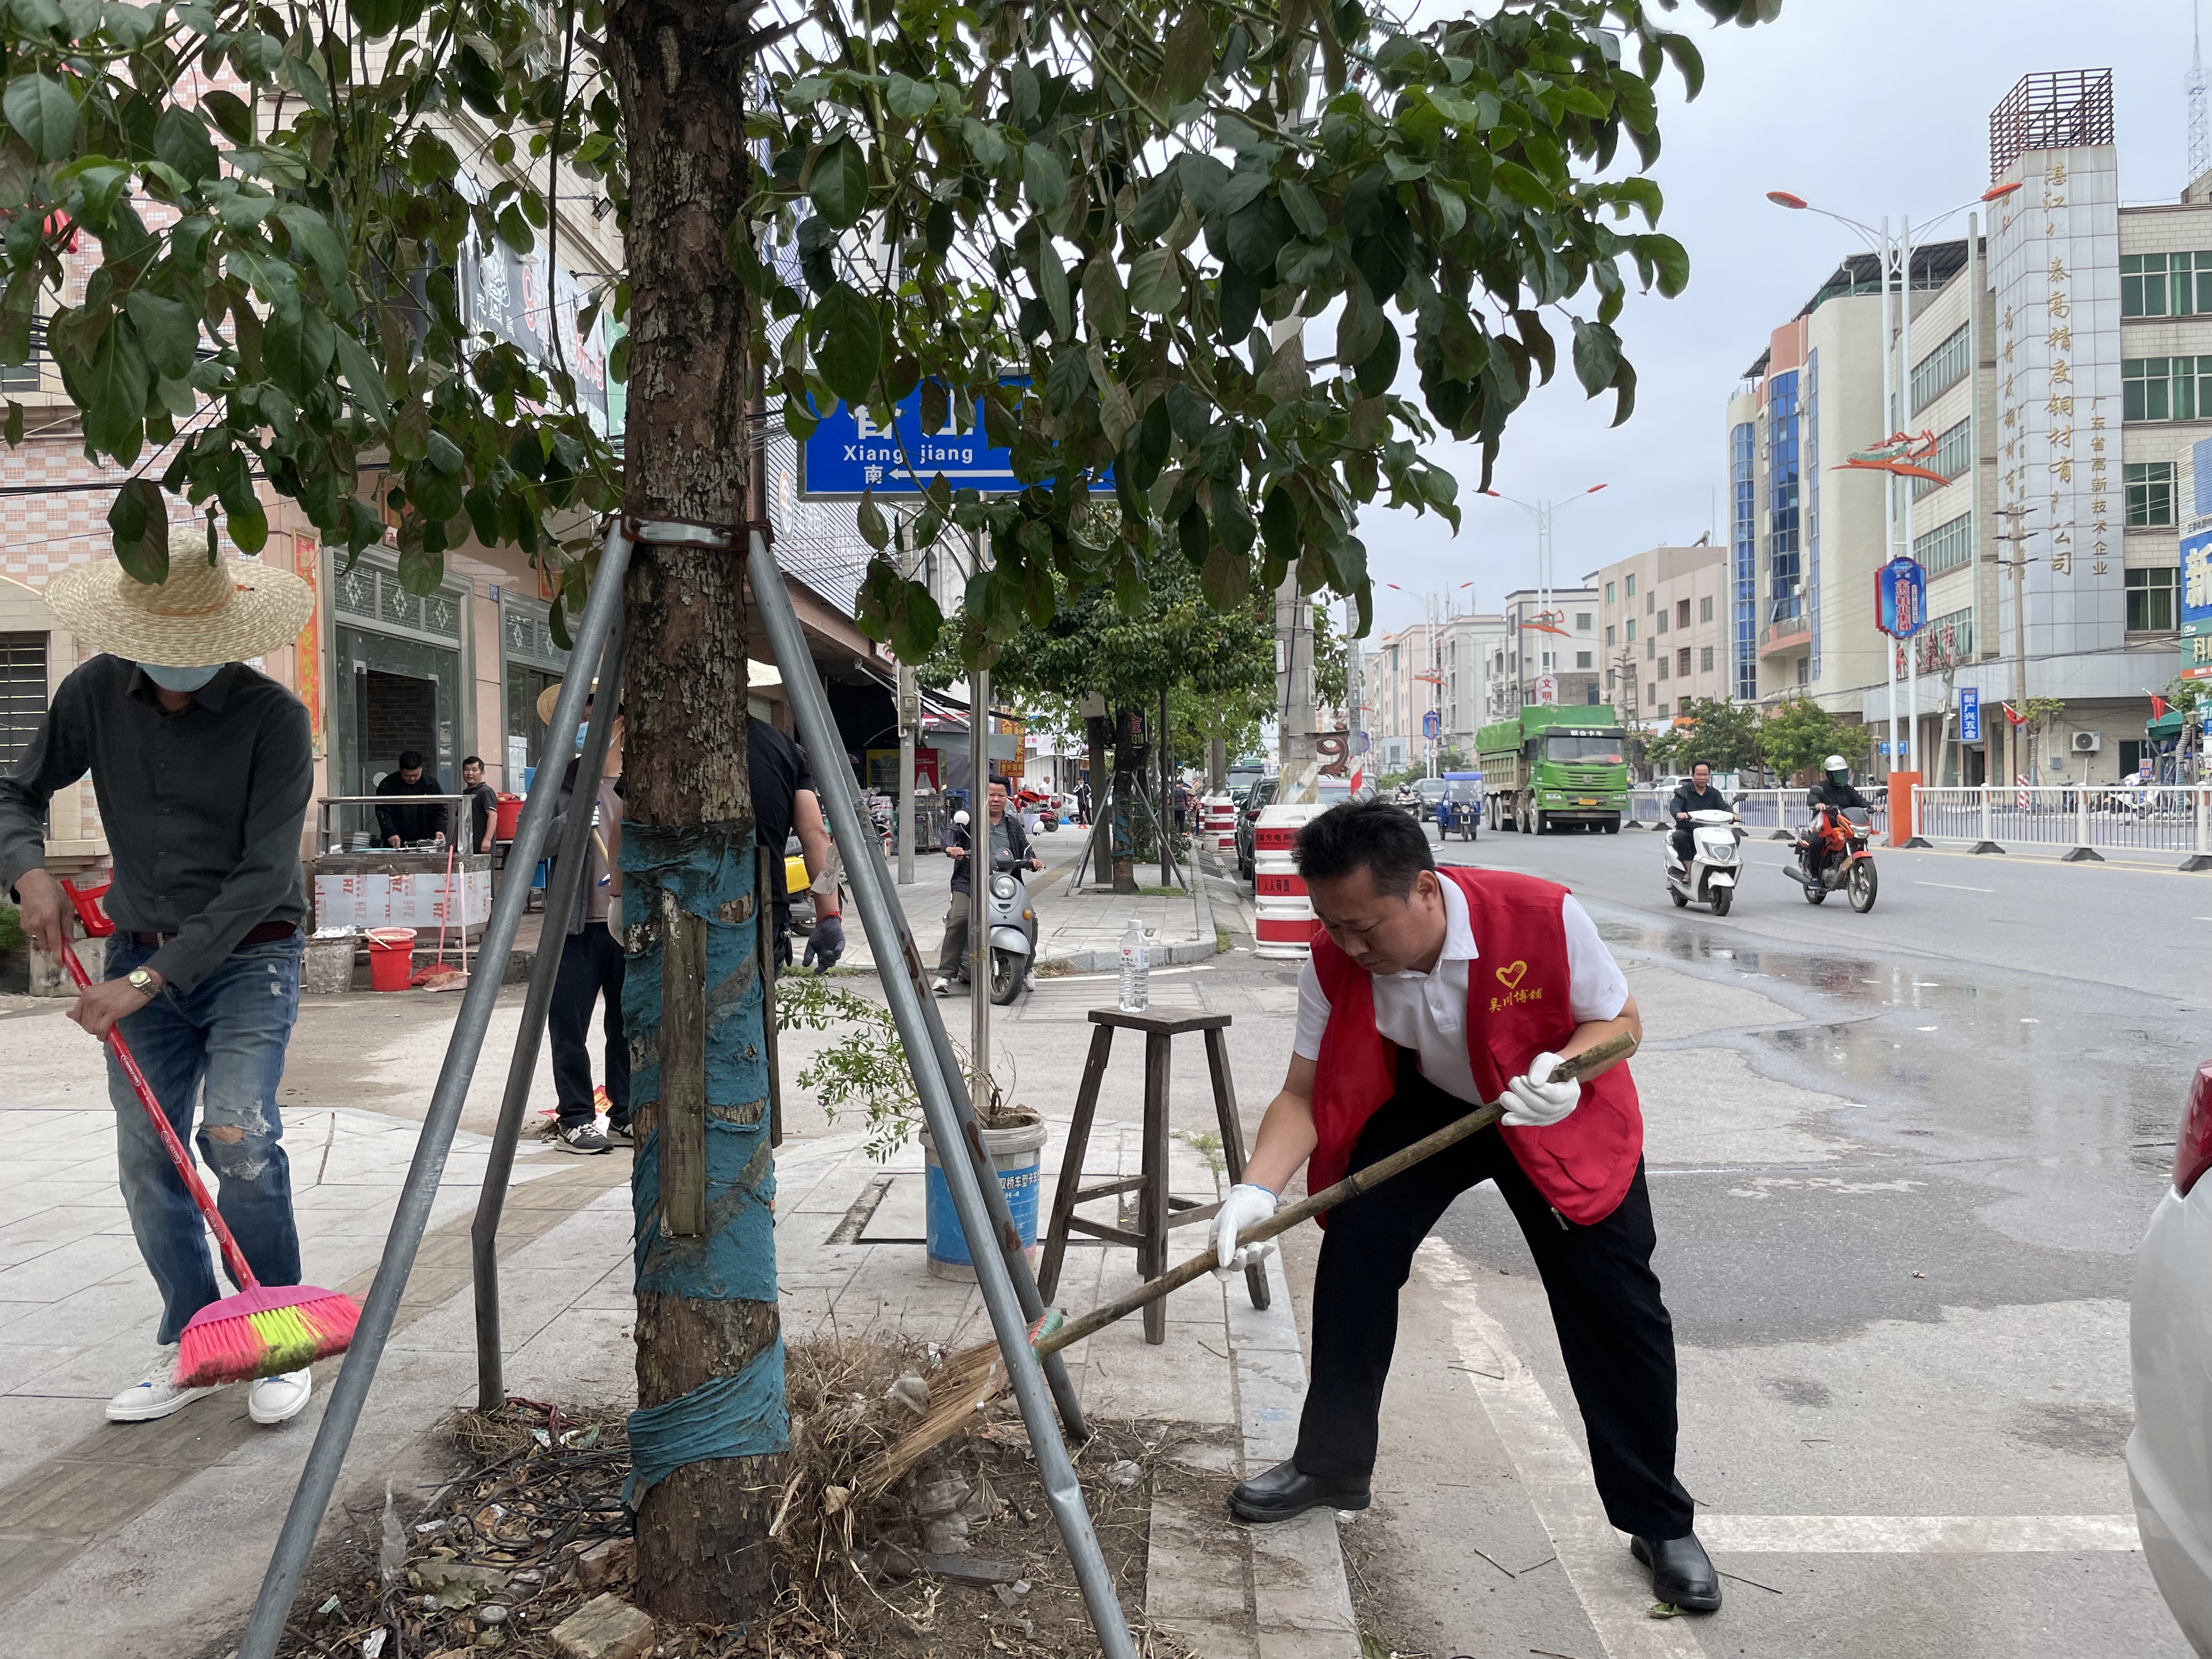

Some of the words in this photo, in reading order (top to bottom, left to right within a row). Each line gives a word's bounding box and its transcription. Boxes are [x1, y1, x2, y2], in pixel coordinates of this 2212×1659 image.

[2043, 161, 2074, 577] 湛江泰高精度铜材有公司
[843, 445, 904, 465] Xiang
[920, 444, 973, 465] jiang
[865, 464, 883, 484] 南
[2090, 396, 2108, 575] 广东省高新技术企业
[1542, 679, 1552, 701] 文明
[1963, 694, 1977, 739] 新广兴五金
[1005, 1190, 1020, 1199] H-4
